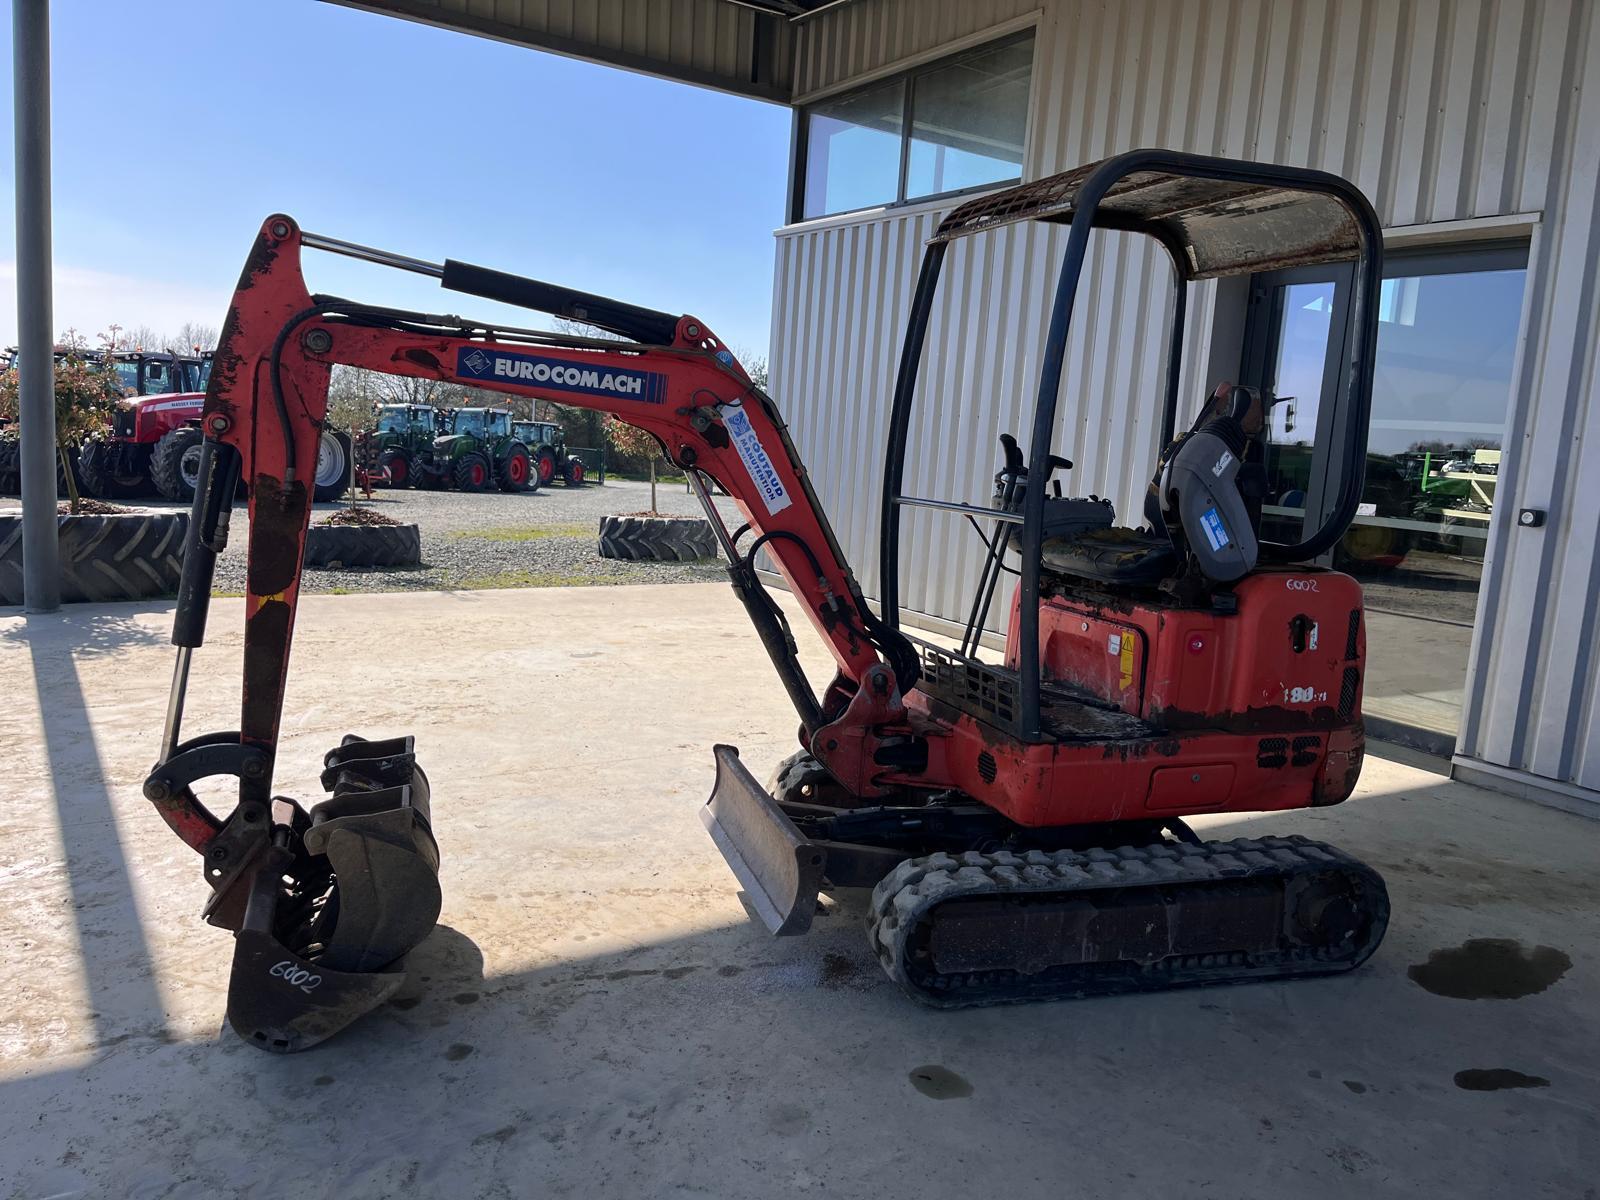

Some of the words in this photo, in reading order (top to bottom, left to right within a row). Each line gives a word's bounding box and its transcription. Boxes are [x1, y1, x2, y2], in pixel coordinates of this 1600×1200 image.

[494, 358, 642, 394] EUROCOMACH
[740, 438, 776, 501] MANUTENTION
[748, 434, 783, 497] COUTAUD
[1286, 579, 1320, 592] 6002
[269, 960, 322, 994] 6002
